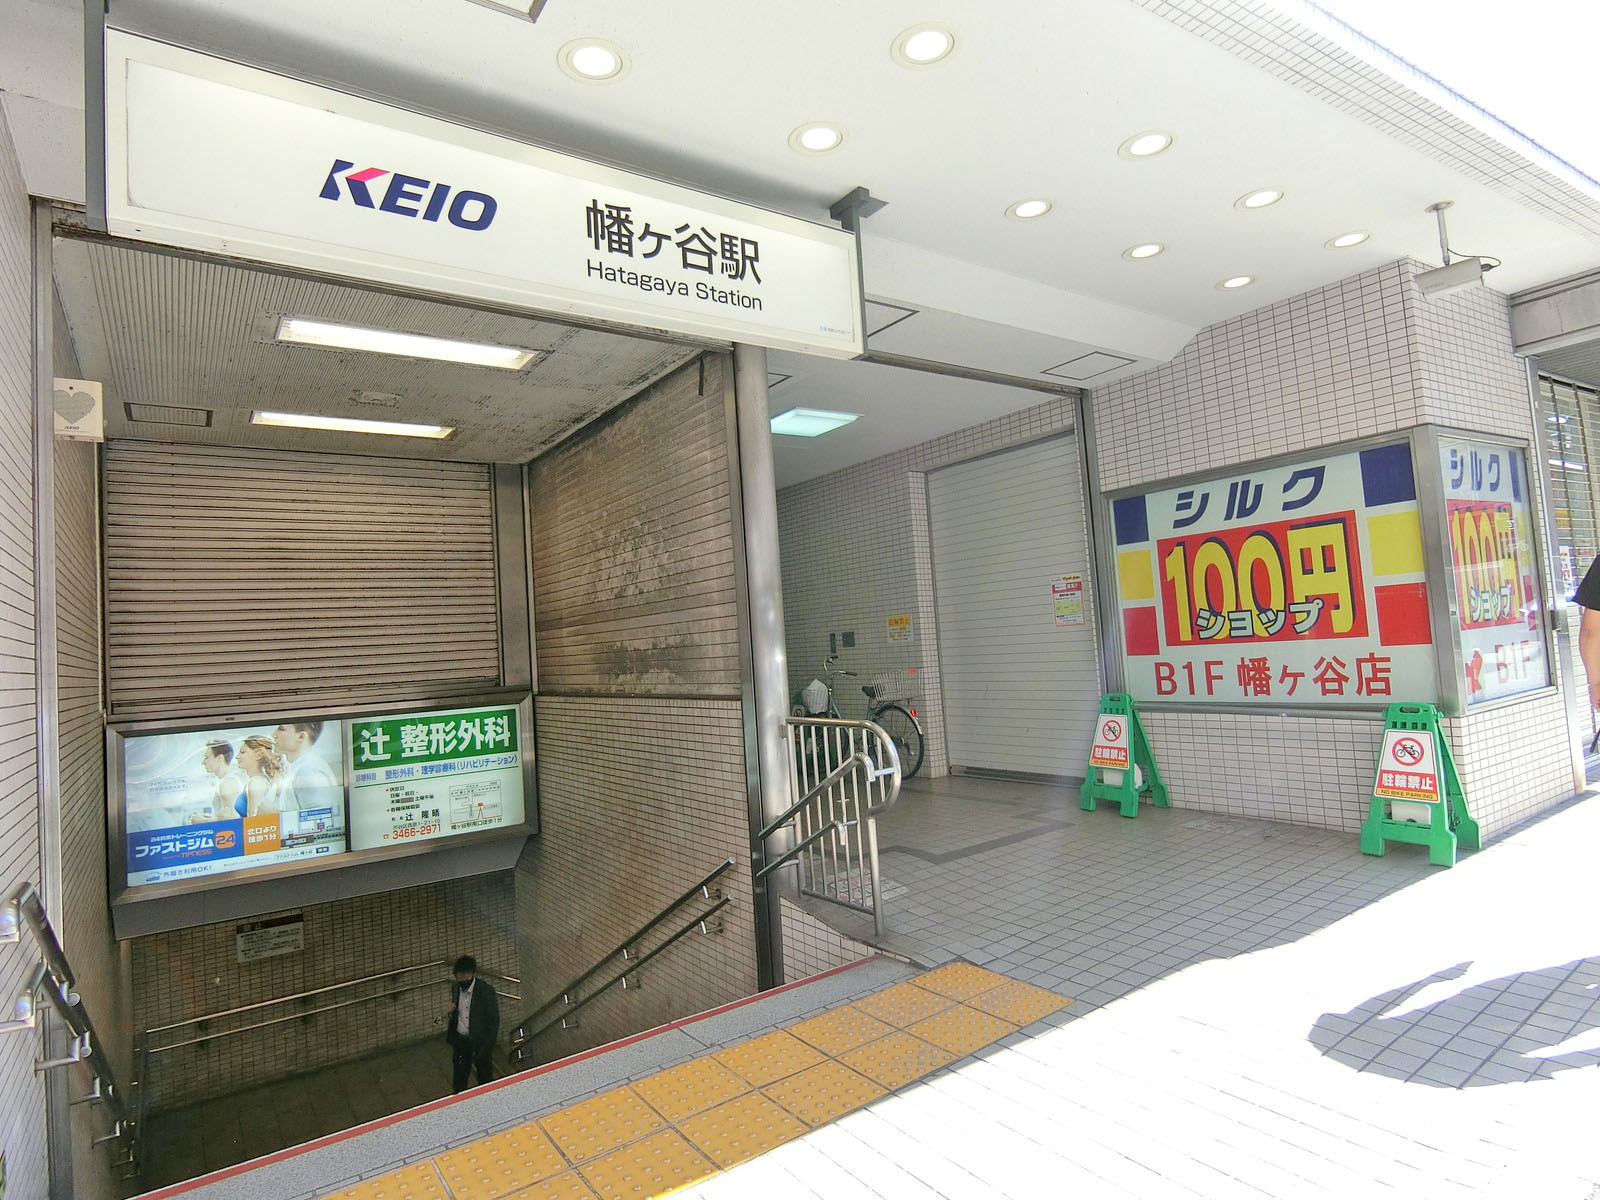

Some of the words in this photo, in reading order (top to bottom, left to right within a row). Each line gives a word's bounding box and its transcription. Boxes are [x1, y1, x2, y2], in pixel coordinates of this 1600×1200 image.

[319, 159, 498, 231] KEIO
[585, 199, 762, 285] 幡ヶ谷駅
[587, 259, 689, 296] Hatagaya
[696, 282, 762, 311] Station
[1450, 448, 1500, 491] シルク
[1173, 465, 1326, 529] シルク
[1165, 517, 1356, 640] 100円
[1195, 598, 1325, 640] ショップ
[1469, 581, 1512, 622] ショップ
[1154, 661, 1223, 696] B1F
[1237, 652, 1392, 697] 幡ヶ谷店
[361, 727, 391, 762] 辻
[400, 715, 511, 758] 整形外科
[1382, 773, 1434, 790] 駐輪禁止
[135, 837, 215, 858] ファストジム
[215, 833, 234, 846] 24
[392, 824, 441, 840] 3466-2971
